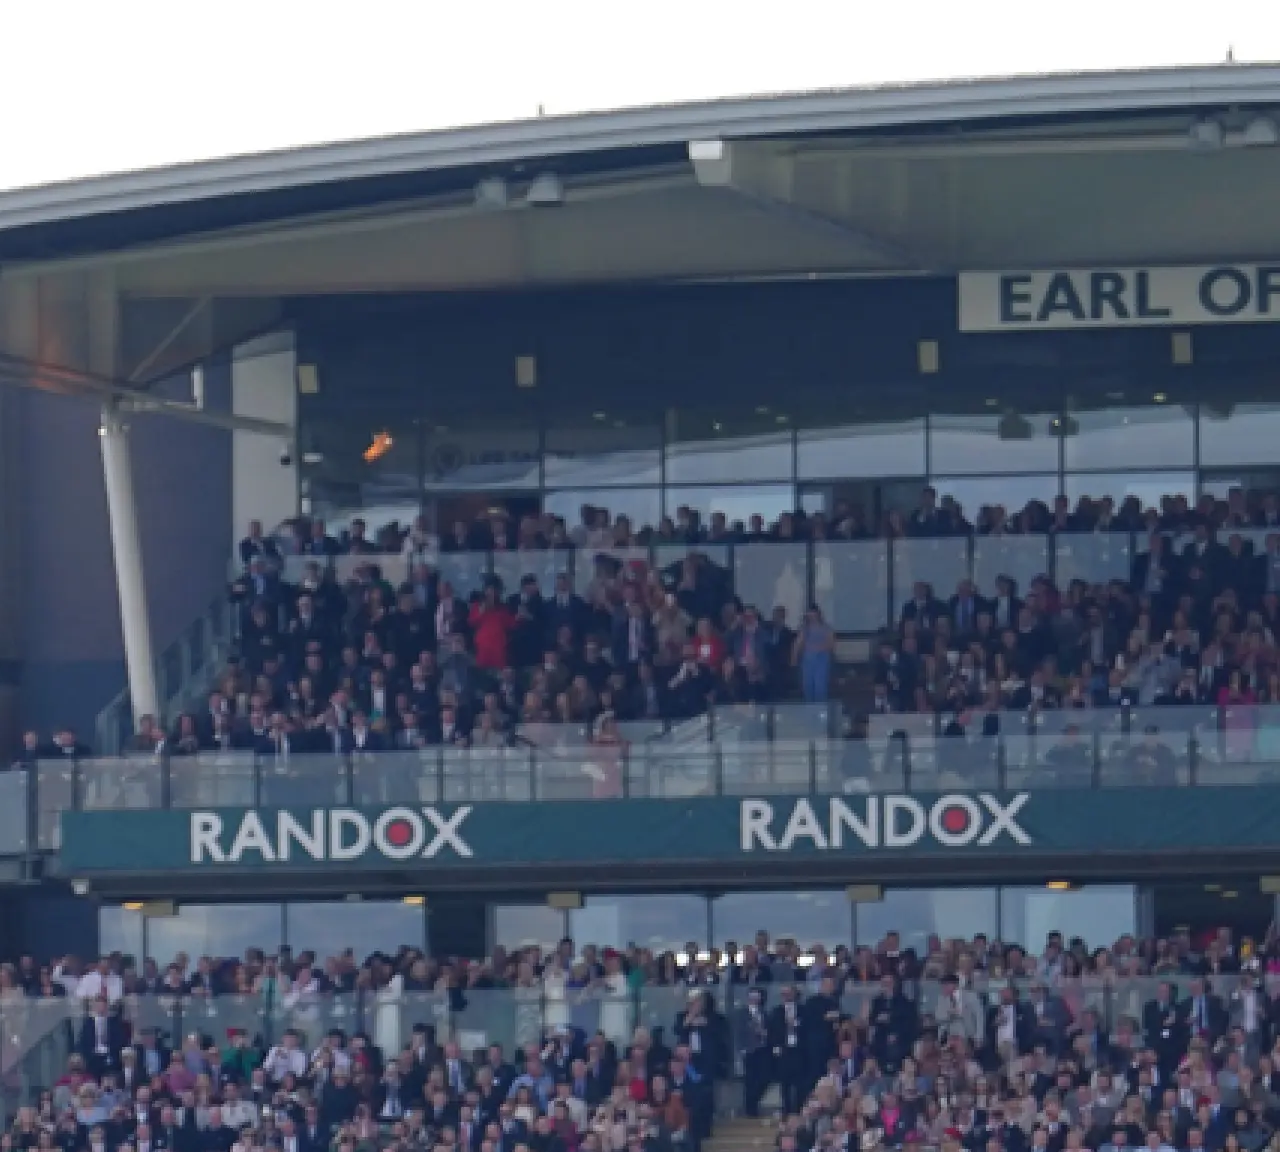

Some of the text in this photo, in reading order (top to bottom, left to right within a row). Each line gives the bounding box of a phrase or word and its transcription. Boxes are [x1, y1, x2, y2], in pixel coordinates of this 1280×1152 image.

[1000, 266, 1280, 321] EARL OF
[190, 805, 474, 862] RANDOX
[741, 791, 1033, 850] RANDOX
